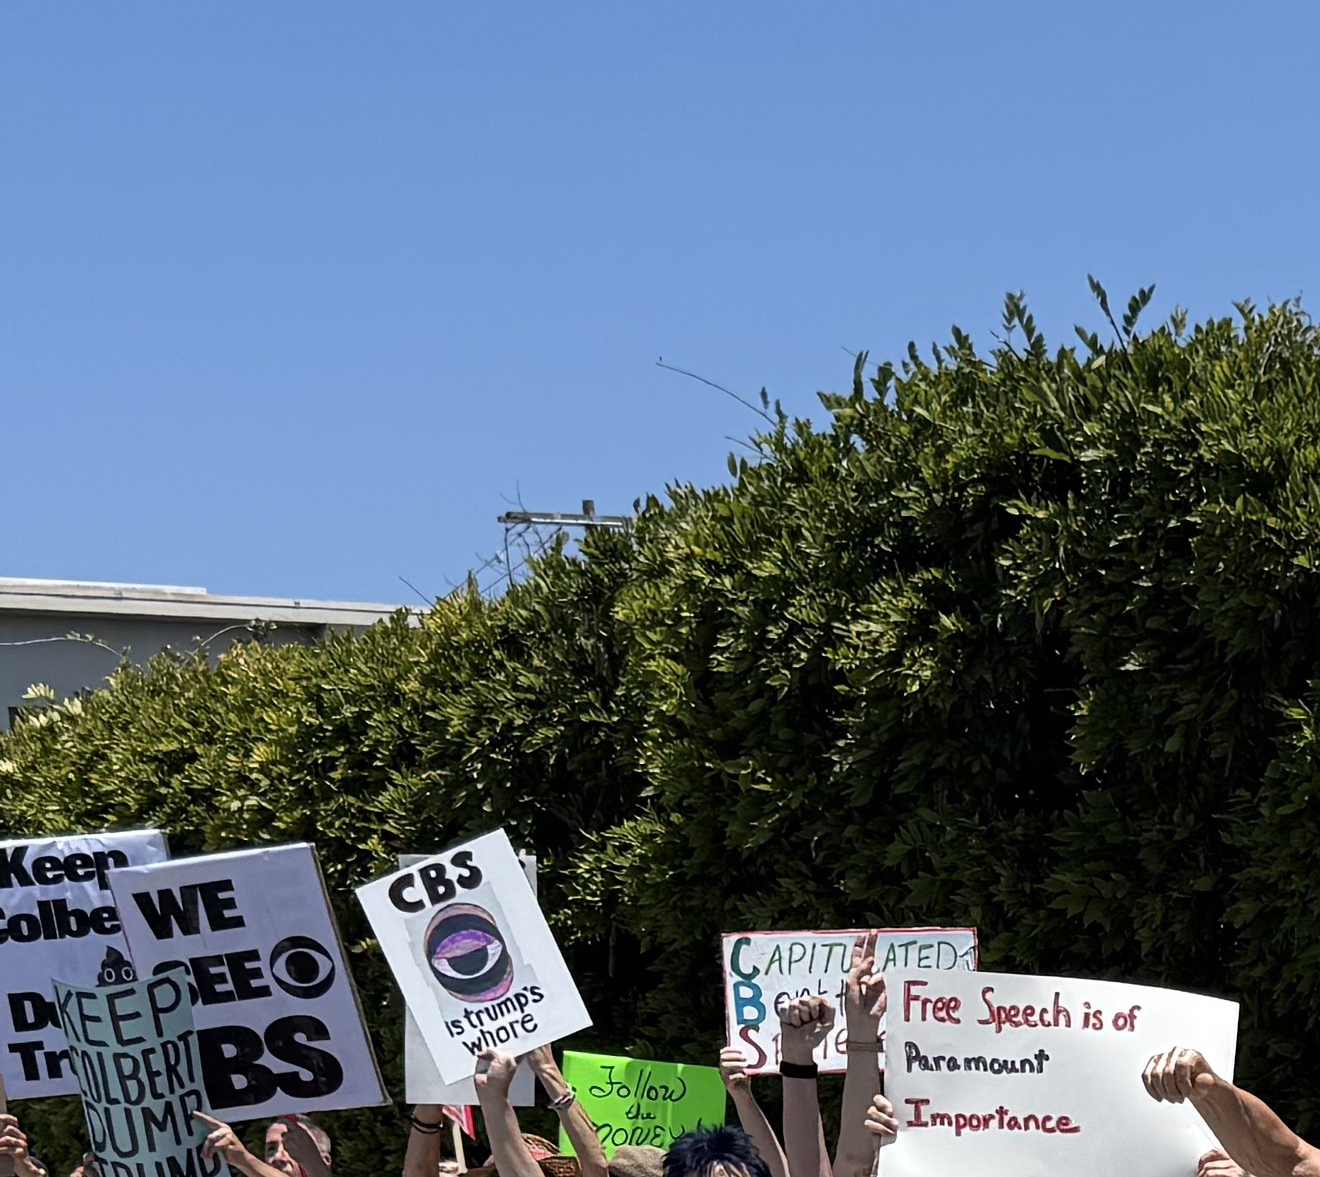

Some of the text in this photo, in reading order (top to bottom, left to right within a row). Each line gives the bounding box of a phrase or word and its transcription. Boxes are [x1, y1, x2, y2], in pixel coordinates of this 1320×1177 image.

[388, 850, 483, 913] CBS
[131, 878, 246, 940] WE
[730, 936, 957, 981] CAPITUATED
[55, 976, 179, 1048] KEEP
[464, 985, 545, 1029] trump's
[903, 980, 962, 1025] Free
[977, 986, 1072, 1034] Speech
[1082, 1002, 1104, 1031] is
[1112, 1005, 1142, 1032] of
[462, 1013, 538, 1056] whore
[904, 1041, 1050, 1075] Paramount
[71, 1030, 197, 1105] COLBERT
[199, 1014, 344, 1110] BS
[589, 1065, 687, 1102] Follow
[84, 1089, 209, 1153] DUMP
[625, 1101, 657, 1120] the
[904, 1097, 1081, 1137] Importance
